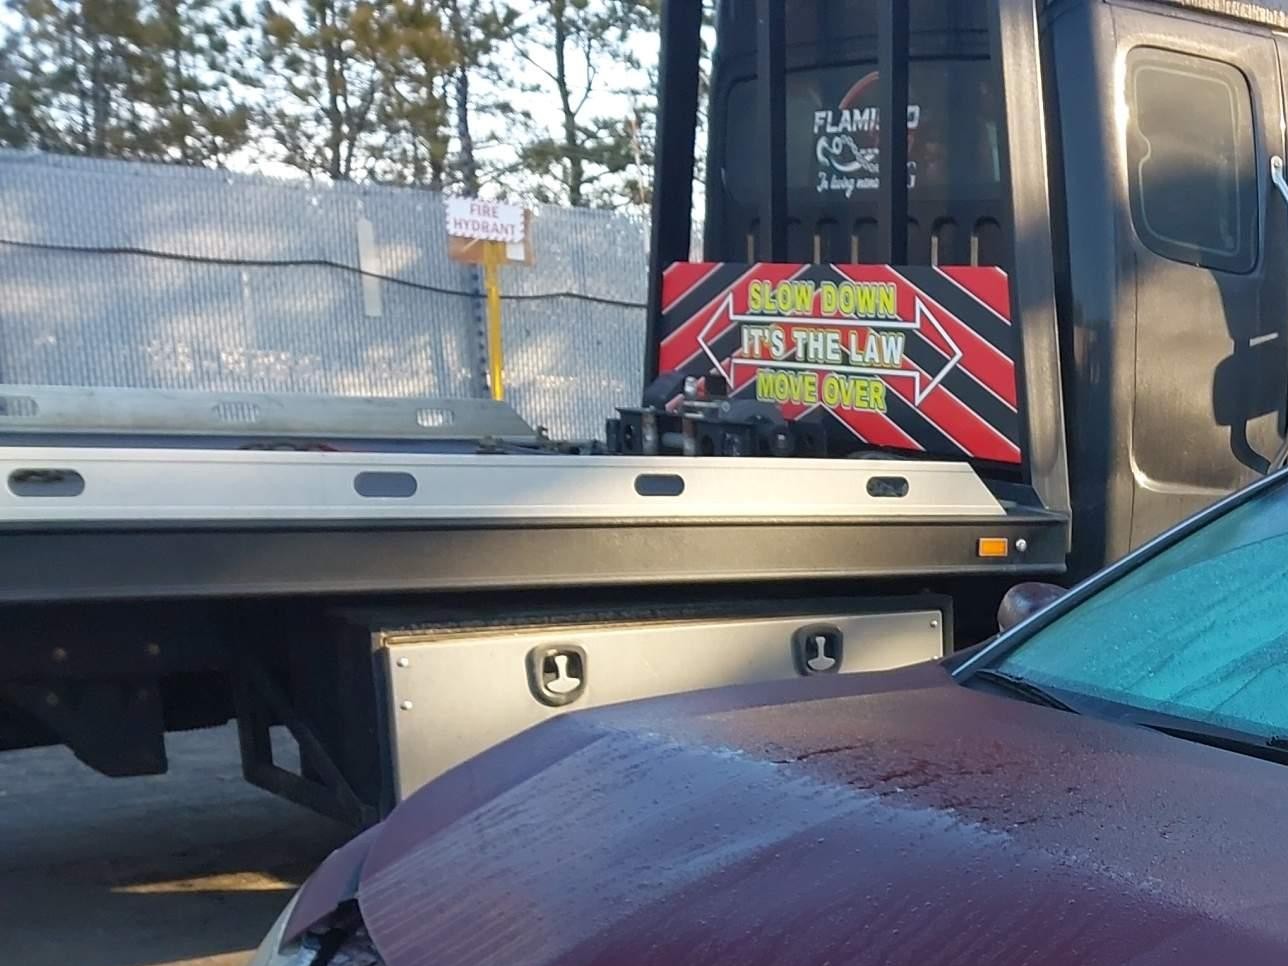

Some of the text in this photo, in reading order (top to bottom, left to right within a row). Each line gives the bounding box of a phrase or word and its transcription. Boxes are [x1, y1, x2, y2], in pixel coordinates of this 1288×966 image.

[813, 104, 921, 134] FLAMIO
[453, 218, 515, 236] HYDRANT
[470, 203, 499, 218] FIRE
[749, 280, 896, 318] SLOW DOWN
[742, 325, 905, 367] IT'S THE LAW
[756, 368, 887, 413] MOVE OVER
